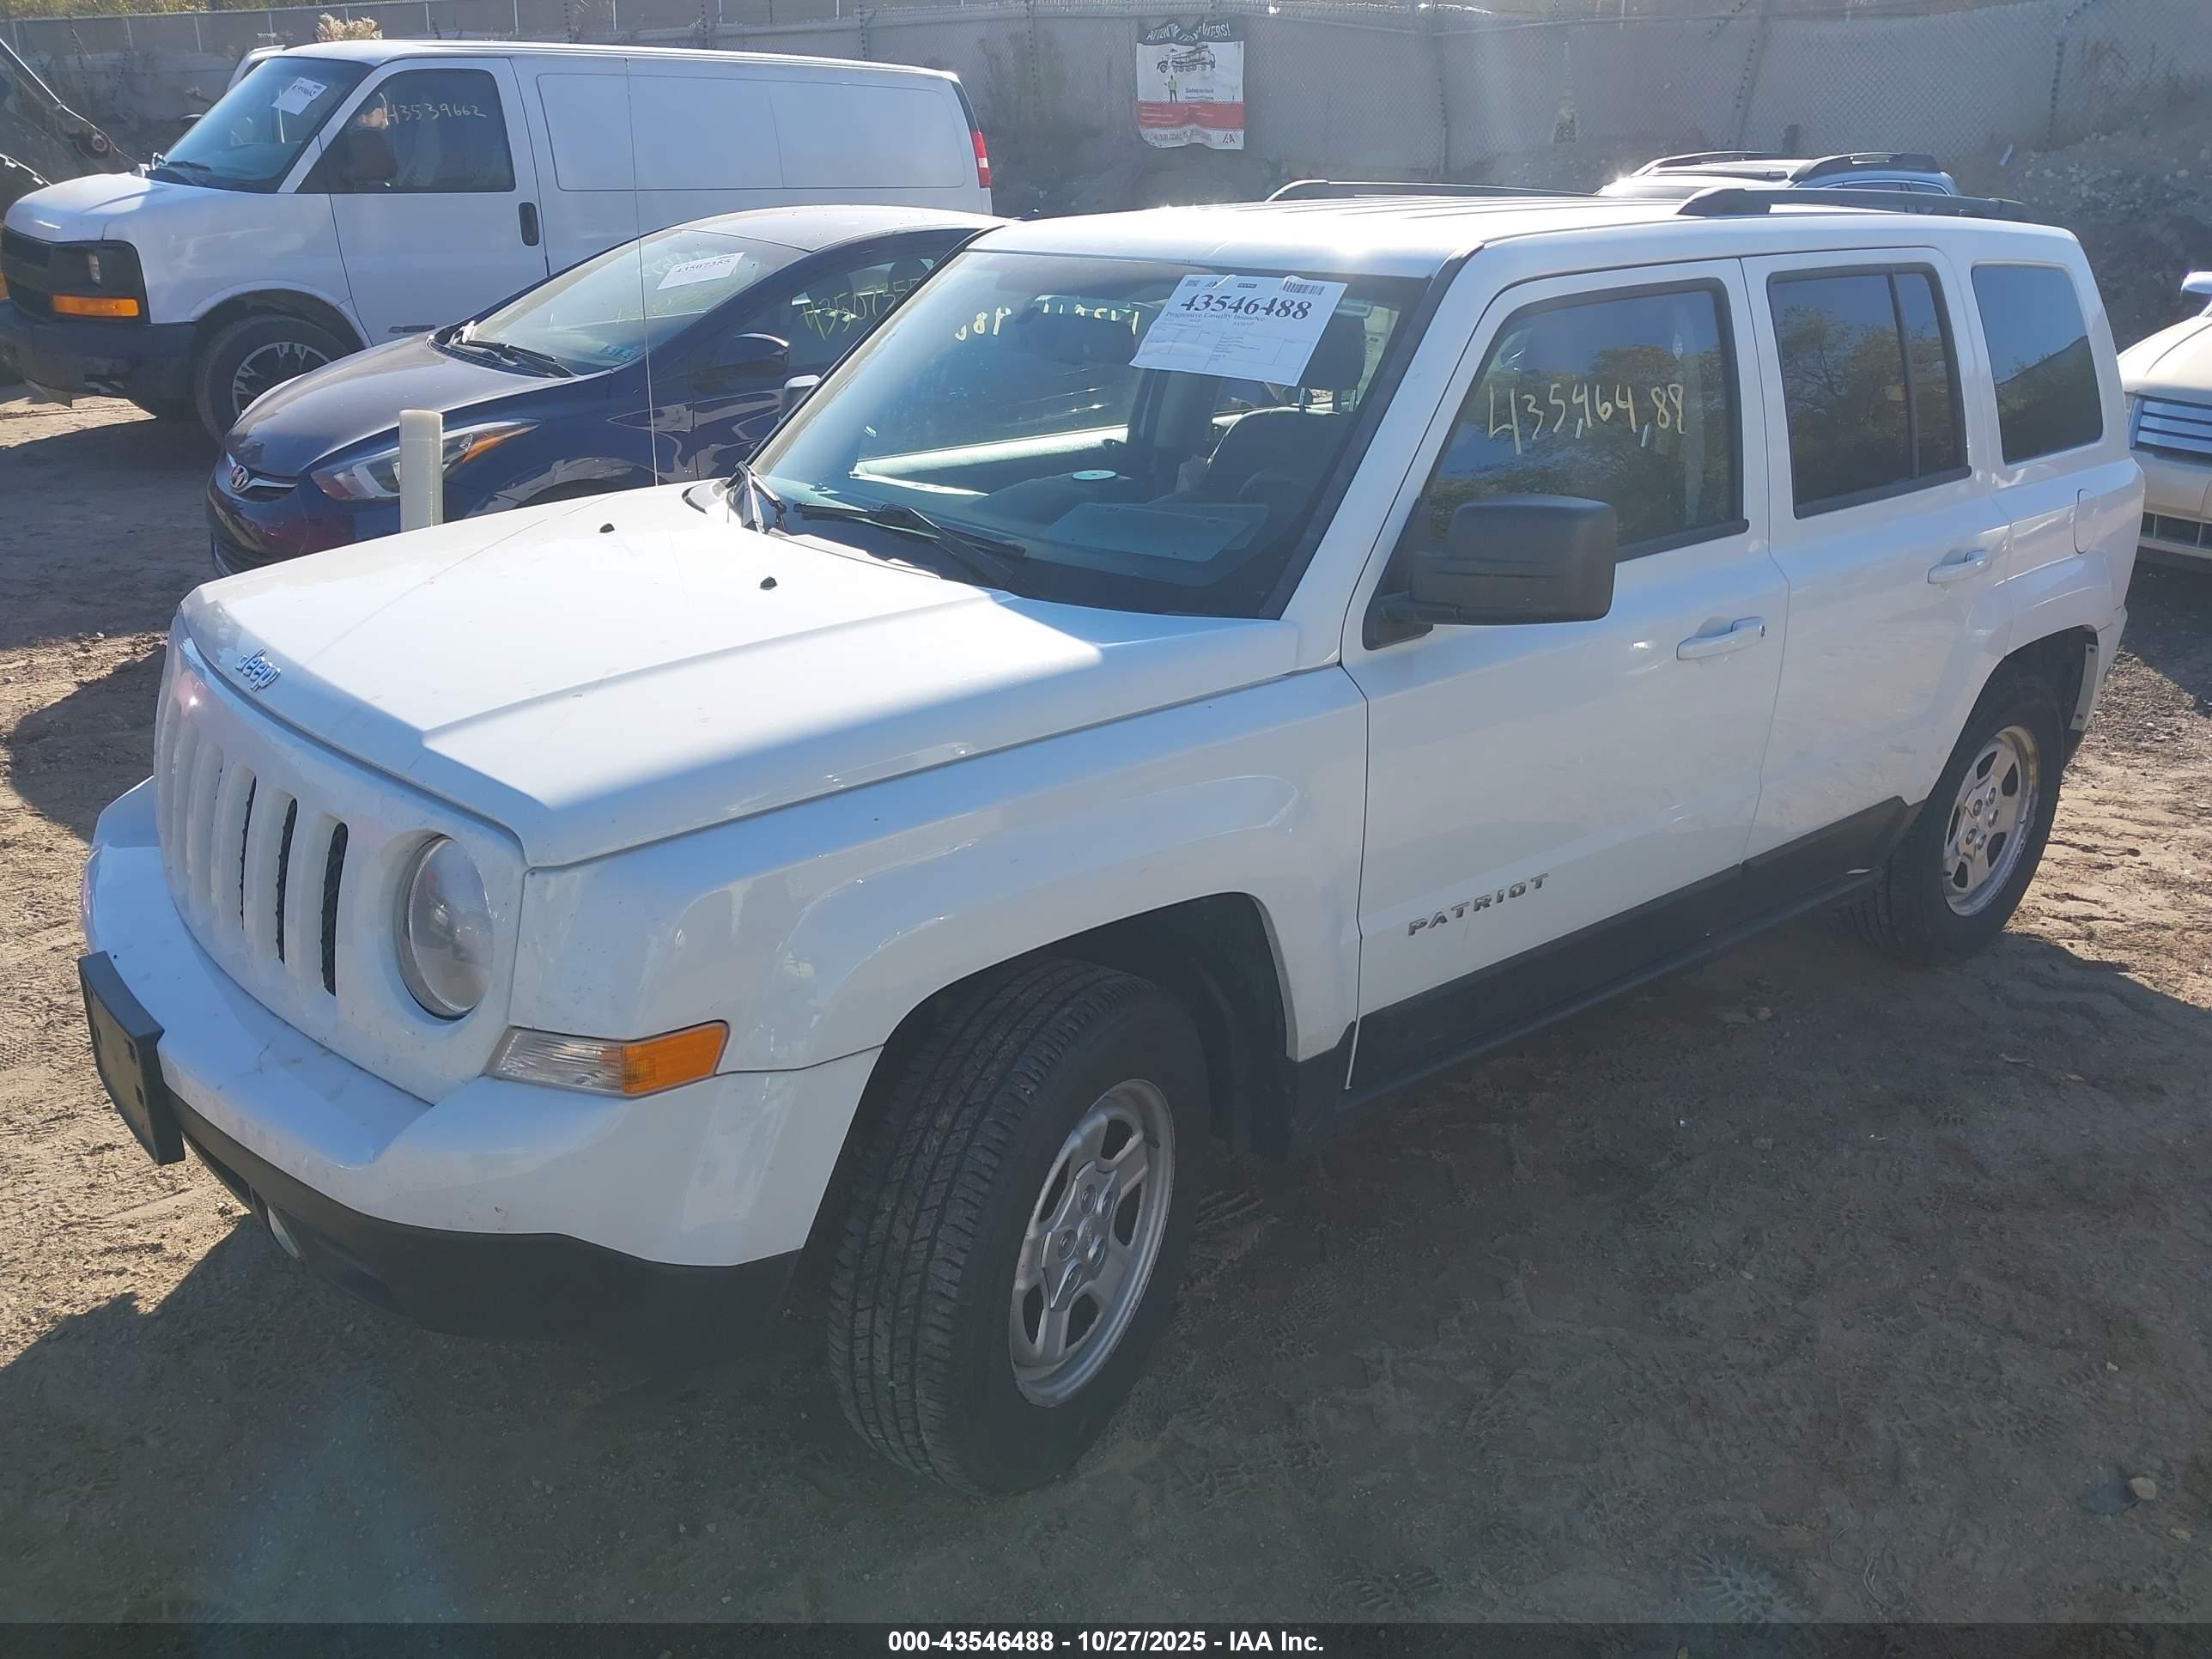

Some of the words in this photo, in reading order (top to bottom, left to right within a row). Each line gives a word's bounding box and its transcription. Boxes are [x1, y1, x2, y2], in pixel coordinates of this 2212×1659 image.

[1180, 294, 1312, 319] 43546488
[235, 647, 282, 691] Jeep
[1408, 872, 1548, 936] PATRIOT
